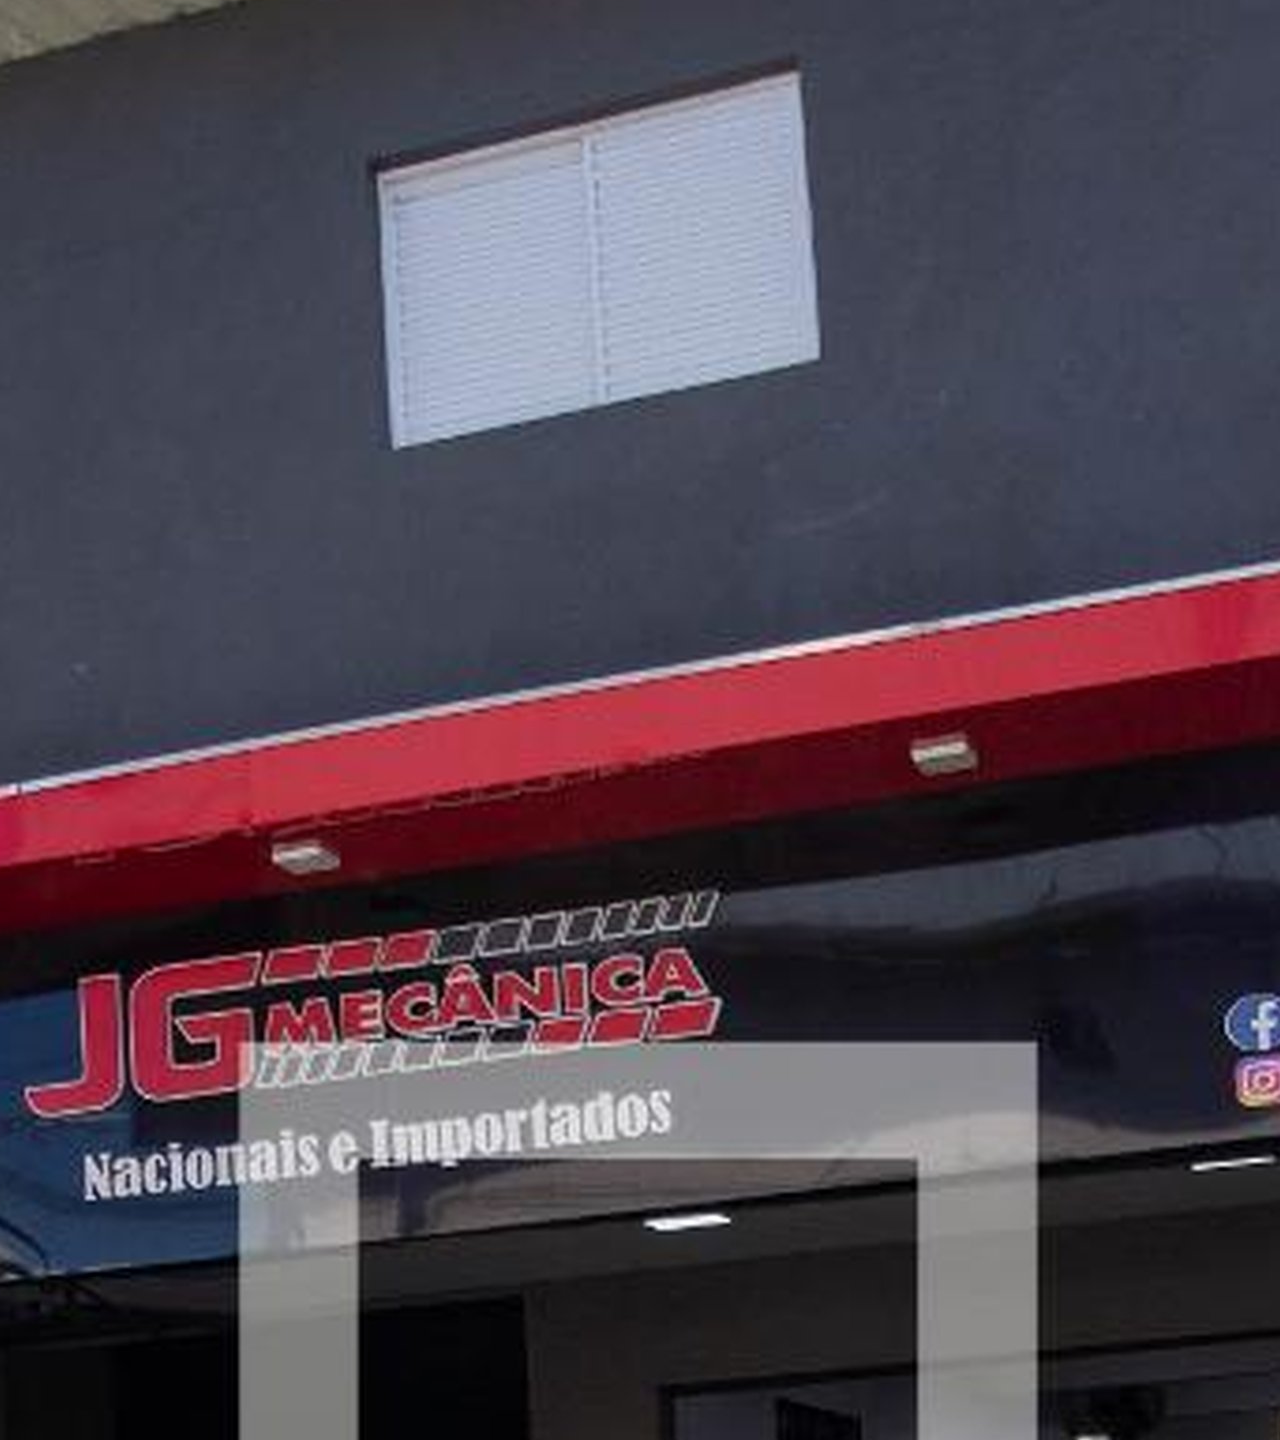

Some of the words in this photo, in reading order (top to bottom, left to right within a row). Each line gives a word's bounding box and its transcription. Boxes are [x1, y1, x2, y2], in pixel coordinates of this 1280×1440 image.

[24, 953, 261, 1118] JG
[264, 947, 708, 1047] MECÂNICA
[83, 1132, 320, 1202] Nacionais
[327, 1134, 360, 1174] e
[368, 1089, 673, 1170] Importados
